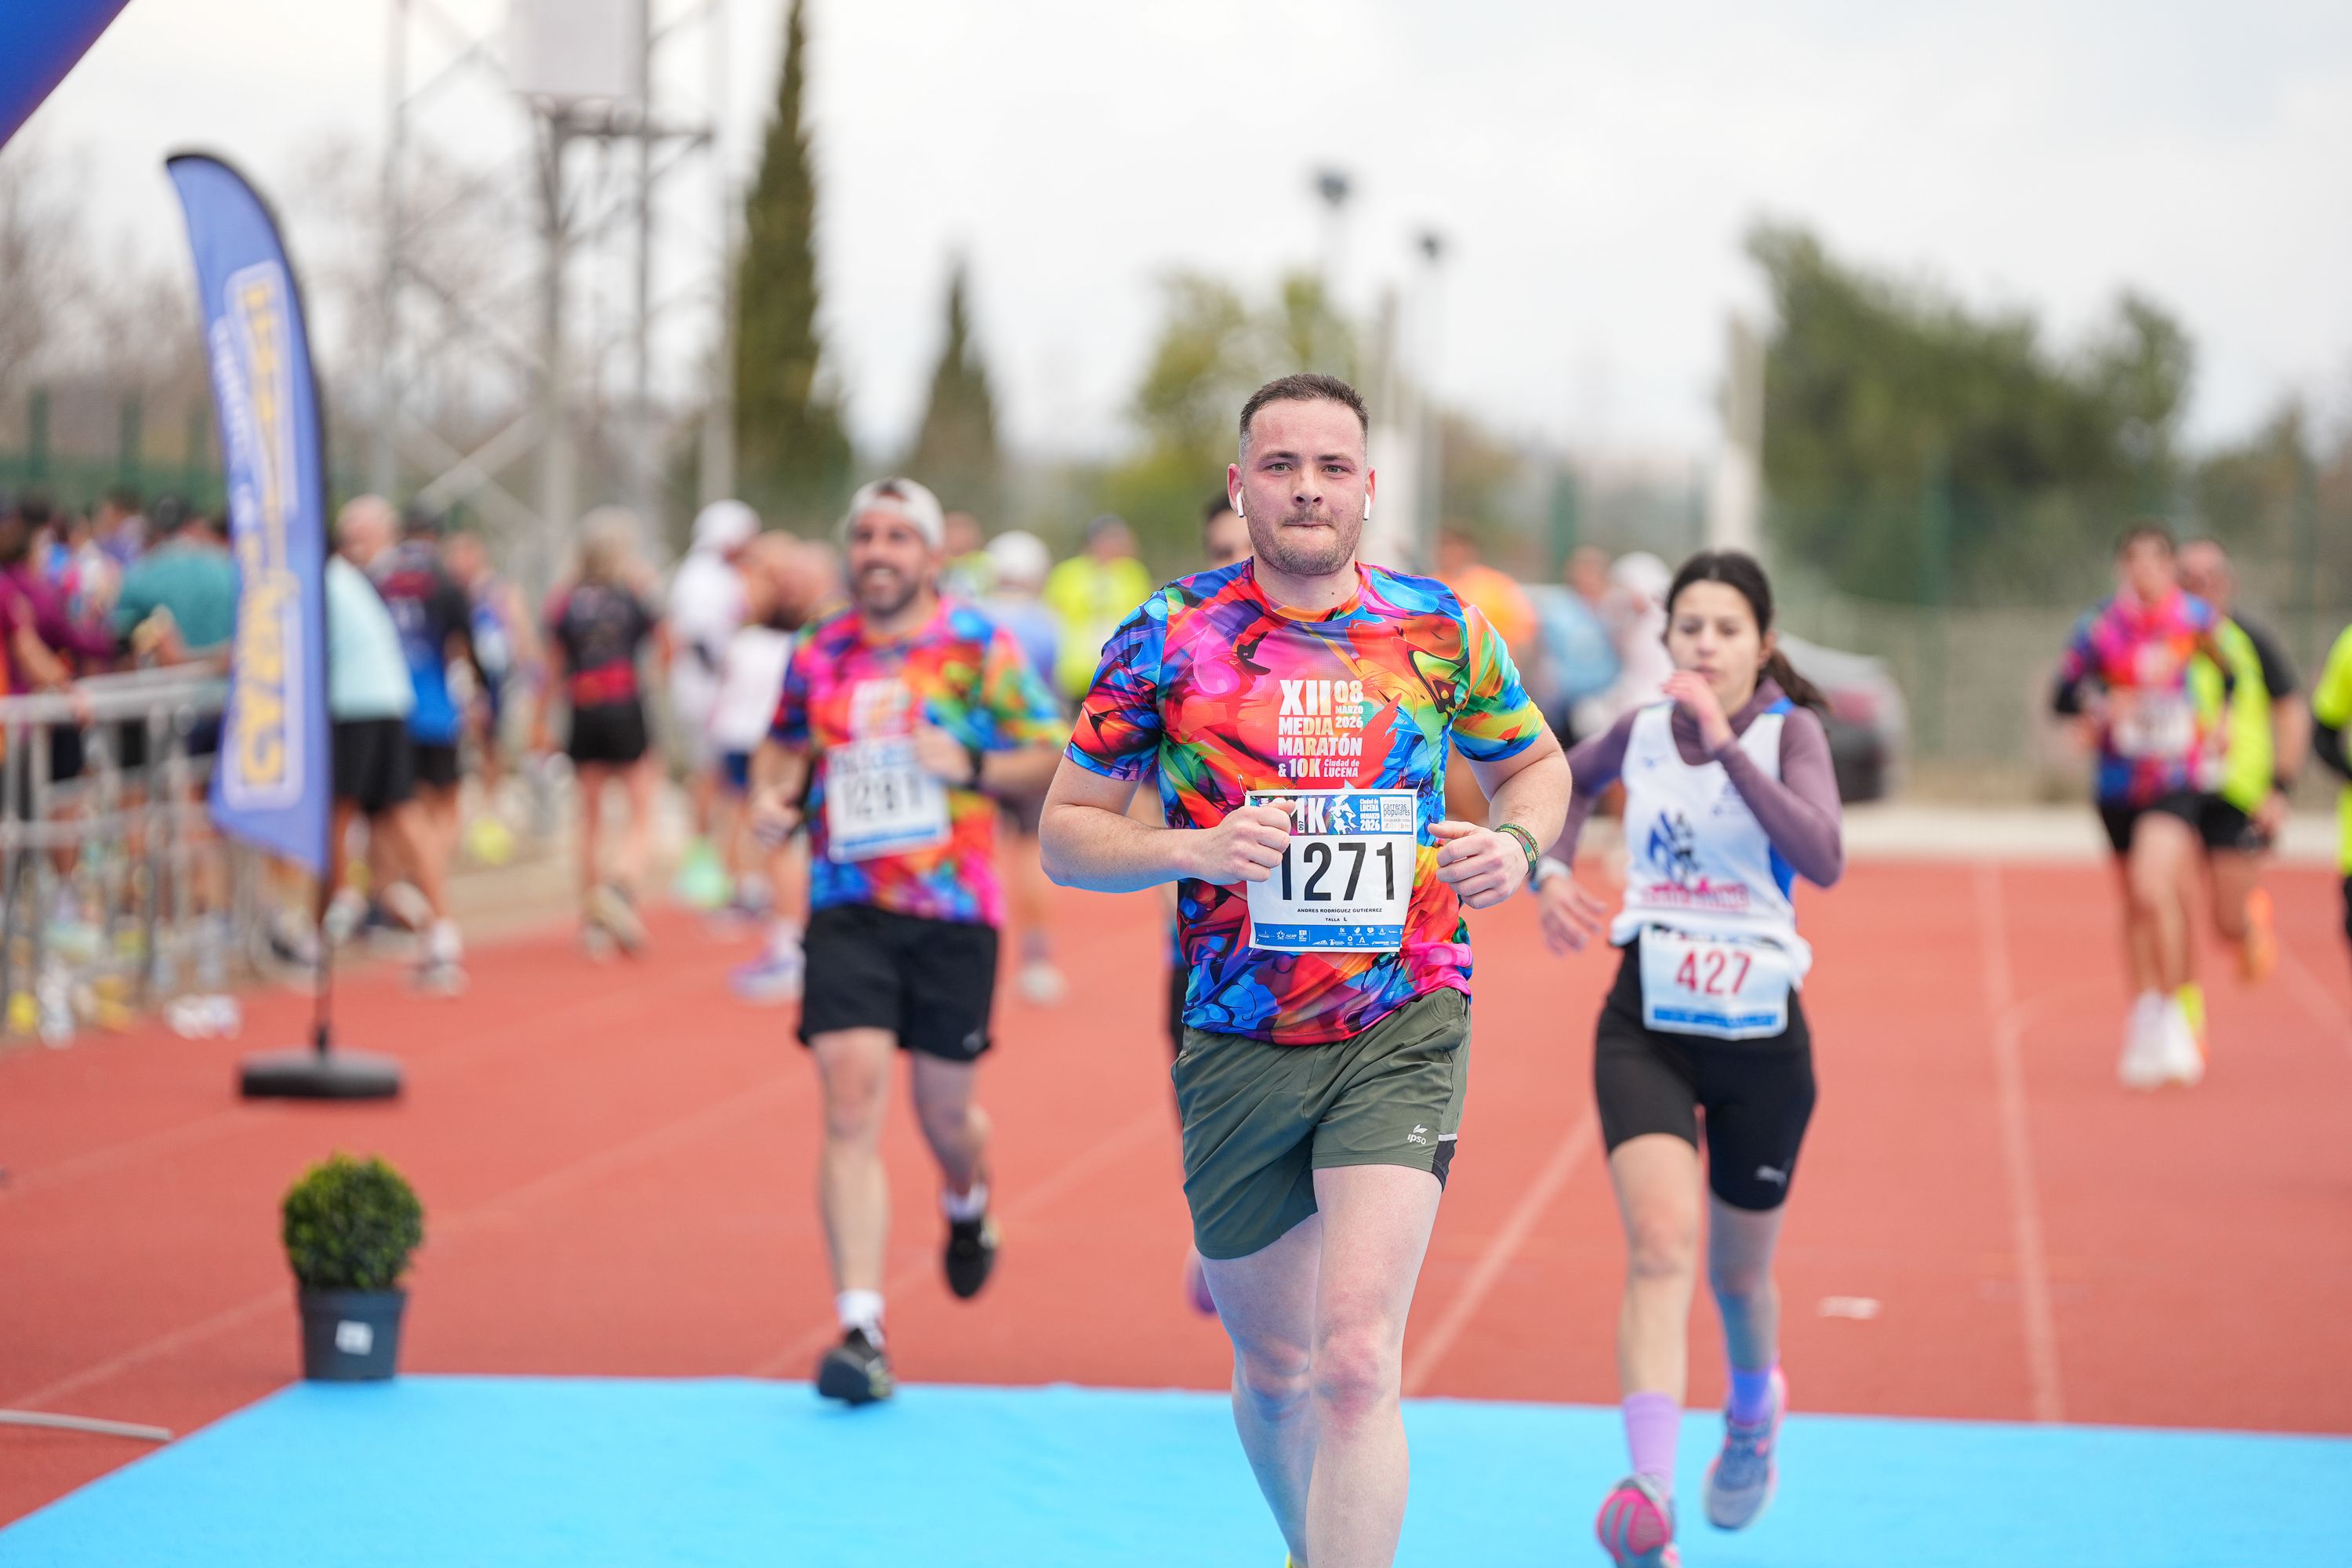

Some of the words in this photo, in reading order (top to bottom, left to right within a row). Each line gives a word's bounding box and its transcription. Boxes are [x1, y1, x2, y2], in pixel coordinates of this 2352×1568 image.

[1279, 680, 1331, 715] XII
[1334, 681, 1363, 703] 08
[1335, 706, 1363, 714] MARZO
[1278, 717, 1334, 735] MEDIA
[1335, 717, 1363, 728] 2026
[1278, 733, 1363, 756] MARATÓN
[1278, 764, 1287, 778] &
[1289, 758, 1322, 778] 10K
[1323, 768, 1359, 778] LUCENA
[1383, 809, 1410, 818] populares
[1360, 819, 1380, 831] 2026
[1282, 842, 1394, 901] 1271
[1675, 949, 1752, 995] 427
